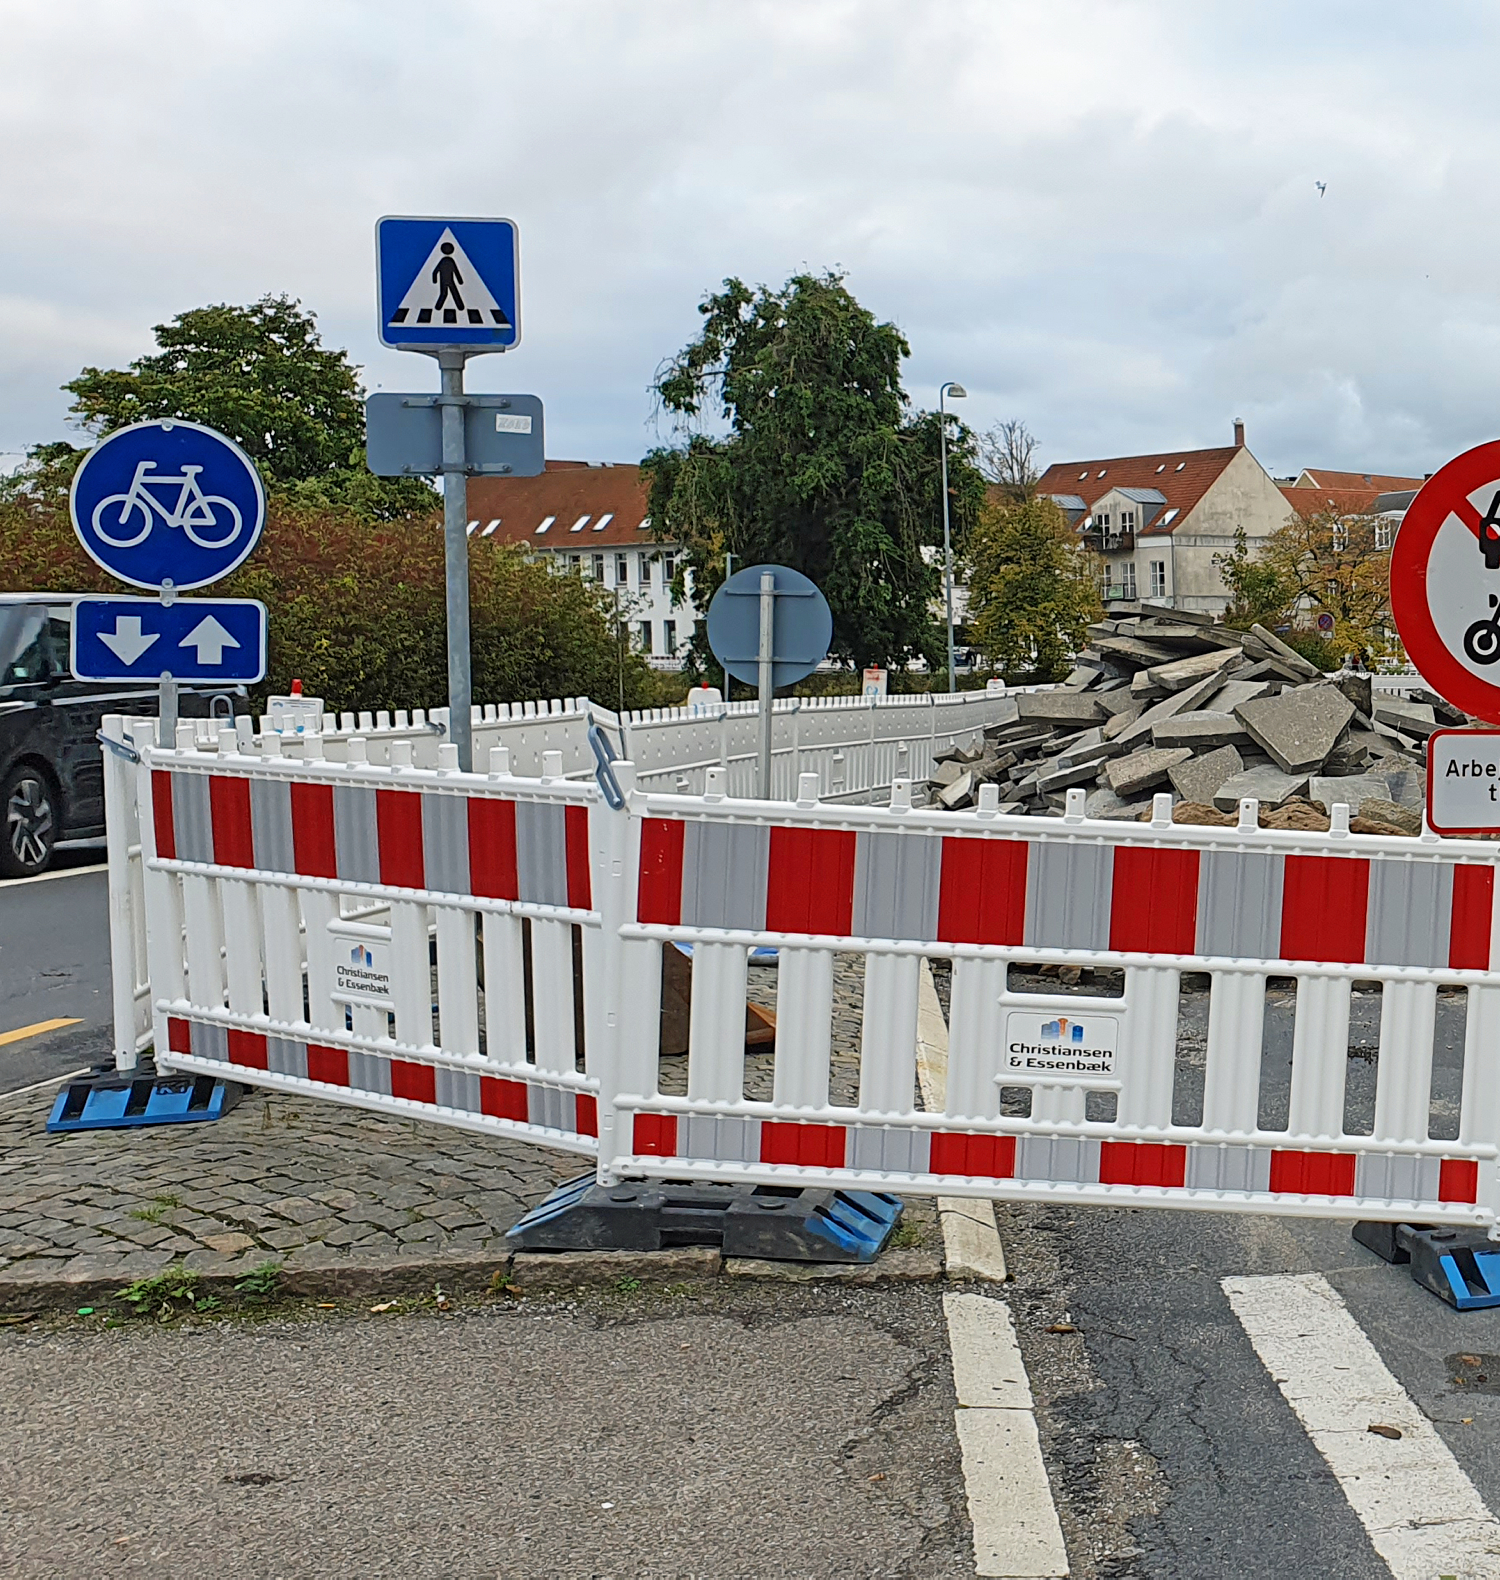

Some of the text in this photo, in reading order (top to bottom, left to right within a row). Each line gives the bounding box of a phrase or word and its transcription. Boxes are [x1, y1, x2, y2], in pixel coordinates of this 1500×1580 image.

[337, 965, 389, 982] Christiansen
[338, 977, 390, 995] & Essenbæk
[1009, 1043, 1112, 1058] Christiansen
[1009, 1057, 1112, 1072] & Essenbæk
